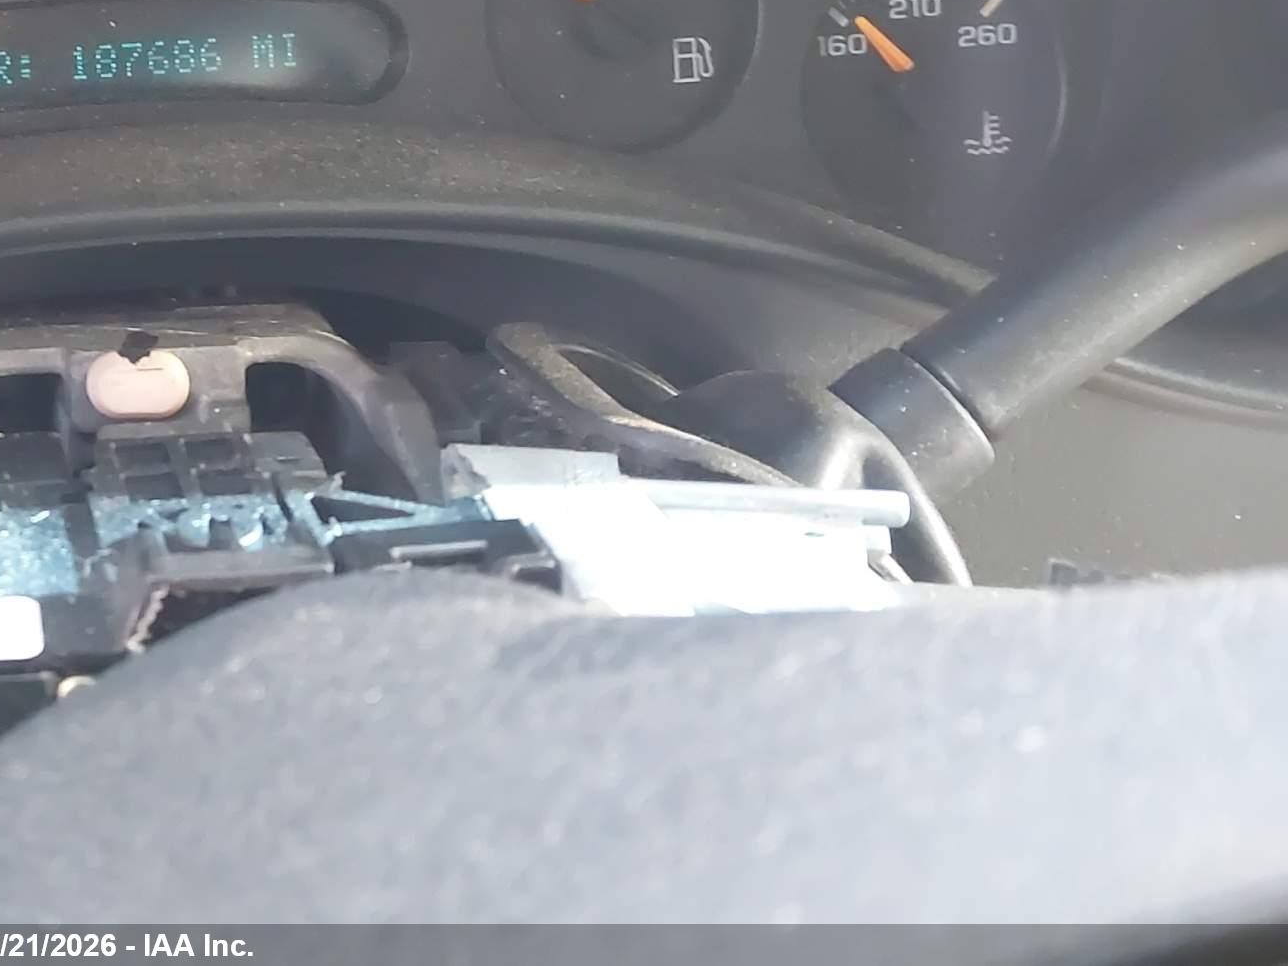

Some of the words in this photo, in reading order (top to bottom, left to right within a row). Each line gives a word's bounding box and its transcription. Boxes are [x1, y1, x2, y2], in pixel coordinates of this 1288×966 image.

[818, 35, 867, 56] 160
[958, 24, 1017, 46] 260
[73, 39, 221, 80] 187686
[251, 33, 296, 69] MI
